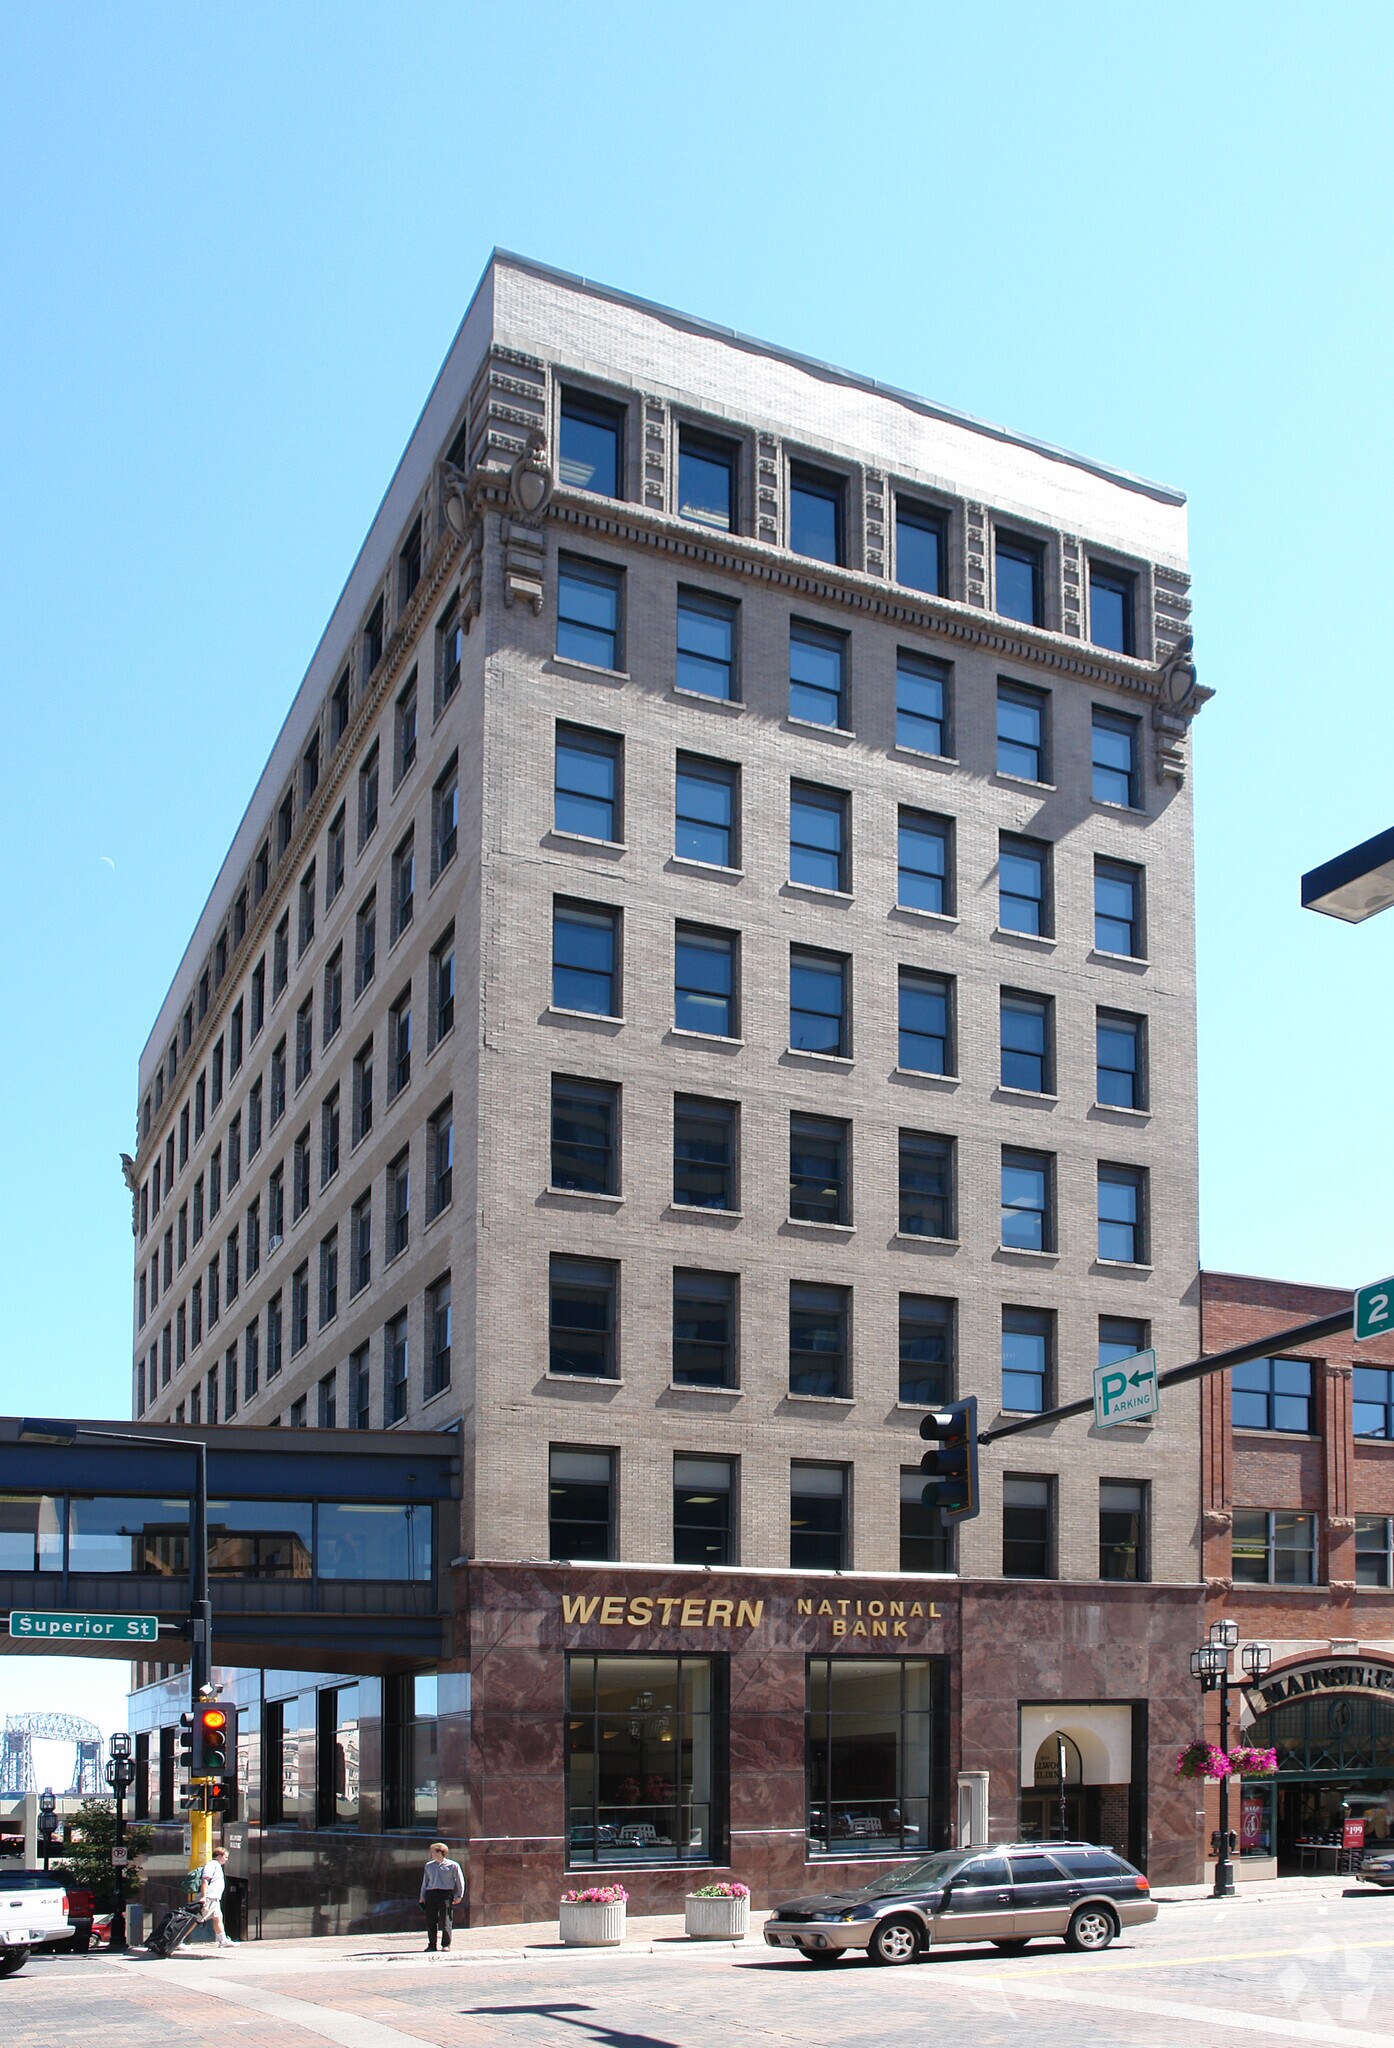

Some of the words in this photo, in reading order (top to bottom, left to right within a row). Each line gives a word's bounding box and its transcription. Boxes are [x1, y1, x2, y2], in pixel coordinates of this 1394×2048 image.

[1368, 1294, 1389, 1325] 2
[561, 1595, 764, 1628] WESTERN
[797, 1598, 943, 1618] NATIONAL
[19, 1617, 114, 1635] Superior
[127, 1621, 149, 1635] St
[832, 1620, 909, 1637] BANK
